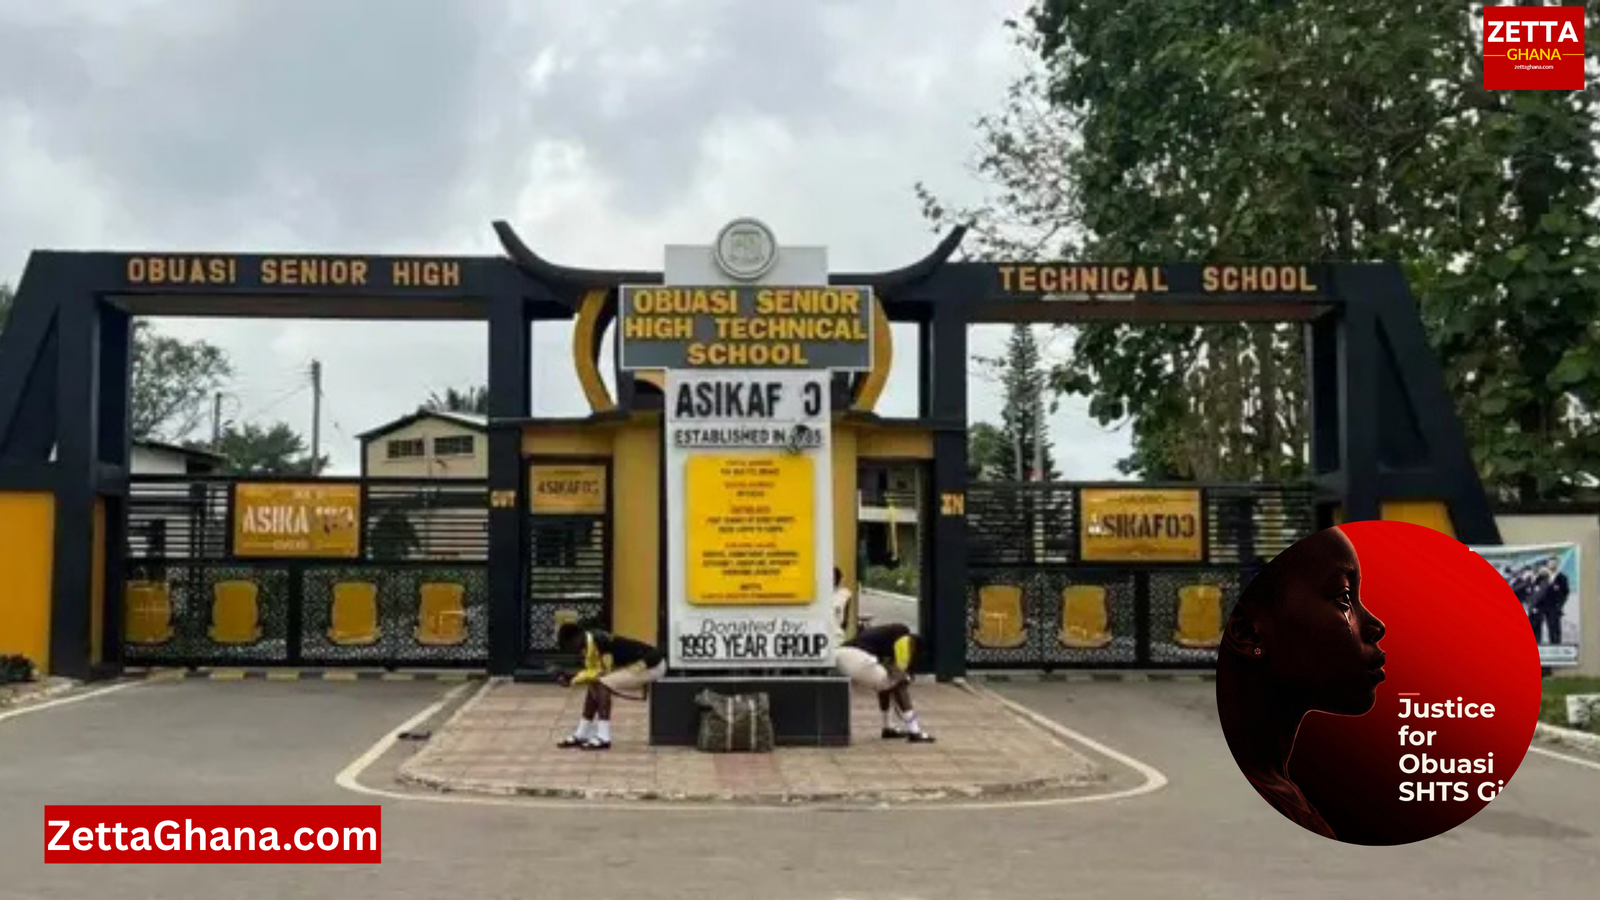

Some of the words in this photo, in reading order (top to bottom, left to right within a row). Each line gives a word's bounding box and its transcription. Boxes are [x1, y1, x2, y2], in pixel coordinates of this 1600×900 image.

[127, 258, 237, 283] OBUASI
[260, 259, 368, 284] SENIOR
[392, 262, 461, 286] HIGH
[998, 266, 1169, 292] TECHNICAL
[1202, 267, 1317, 292] SCHOOL
[633, 289, 738, 314] OBUASI
[756, 289, 860, 314] SENIOR
[625, 317, 694, 338] HIGH
[715, 317, 868, 339] TECHNICAL
[687, 342, 809, 366] SCHOOL
[675, 429, 770, 444] ESTABLISHED
[773, 430, 786, 444] IN
[941, 493, 965, 515] IN
[702, 618, 776, 634] Donated
[679, 633, 717, 657] 1993
[722, 633, 768, 657] YEAR
[774, 633, 829, 657] GROUP
